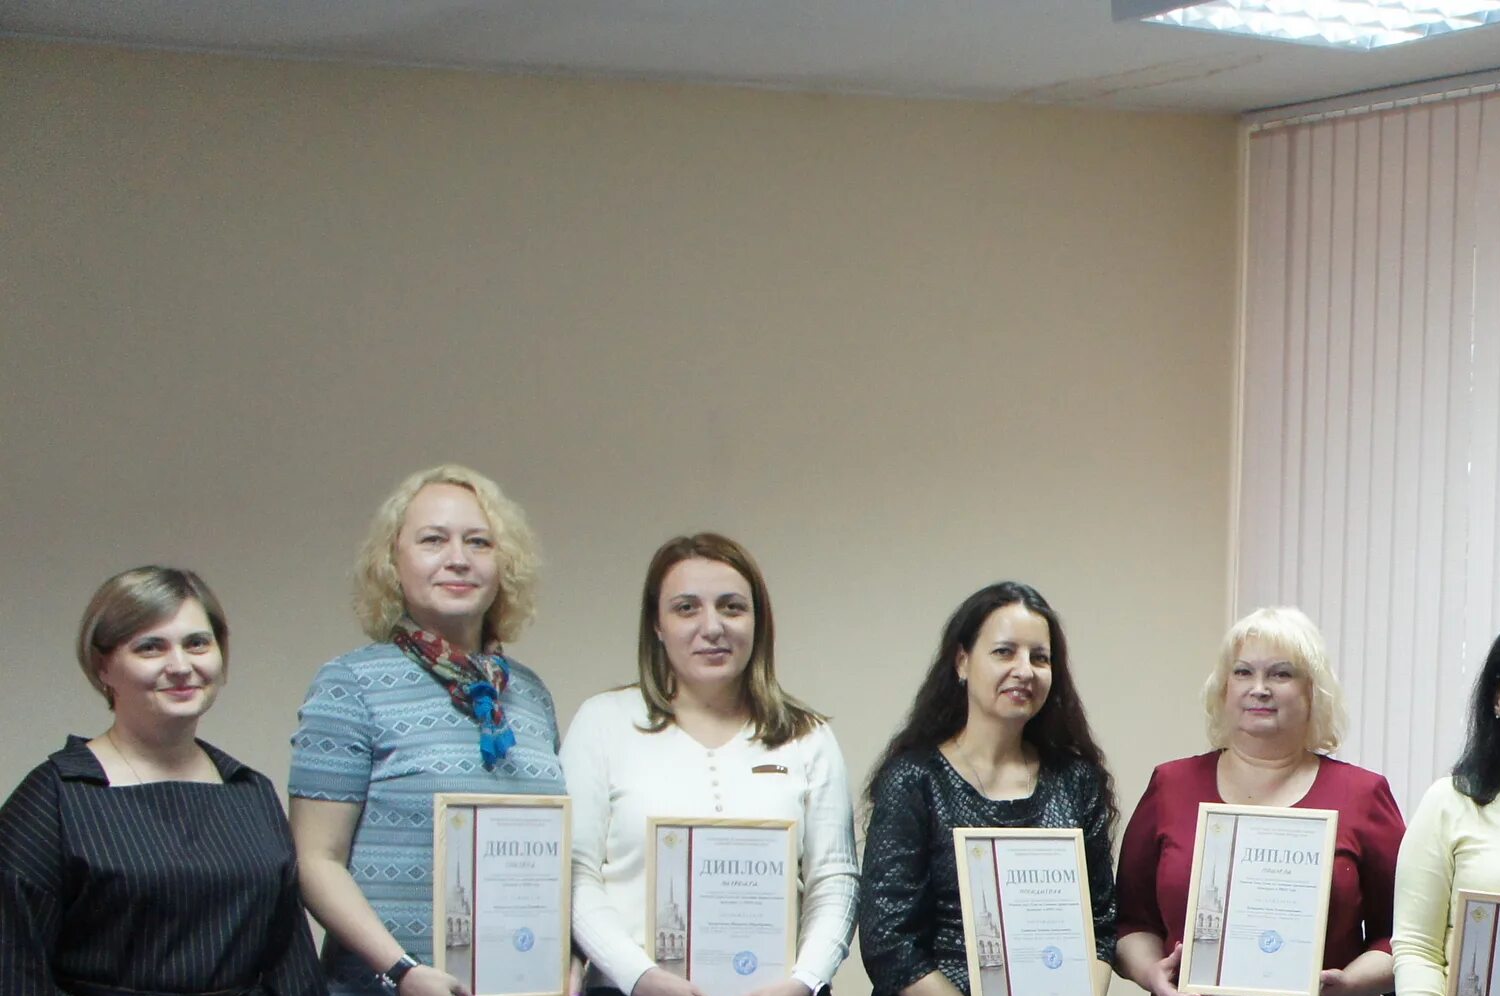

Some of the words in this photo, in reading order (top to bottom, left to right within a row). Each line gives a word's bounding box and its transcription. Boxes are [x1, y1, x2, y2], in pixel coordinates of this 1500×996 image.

[483, 840, 558, 858] ДИПЛОМ
[1241, 848, 1320, 866] ДИПЛОМ
[700, 860, 784, 877] ДИПЛОМ
[1006, 869, 1076, 886] ДИПЛОМ
